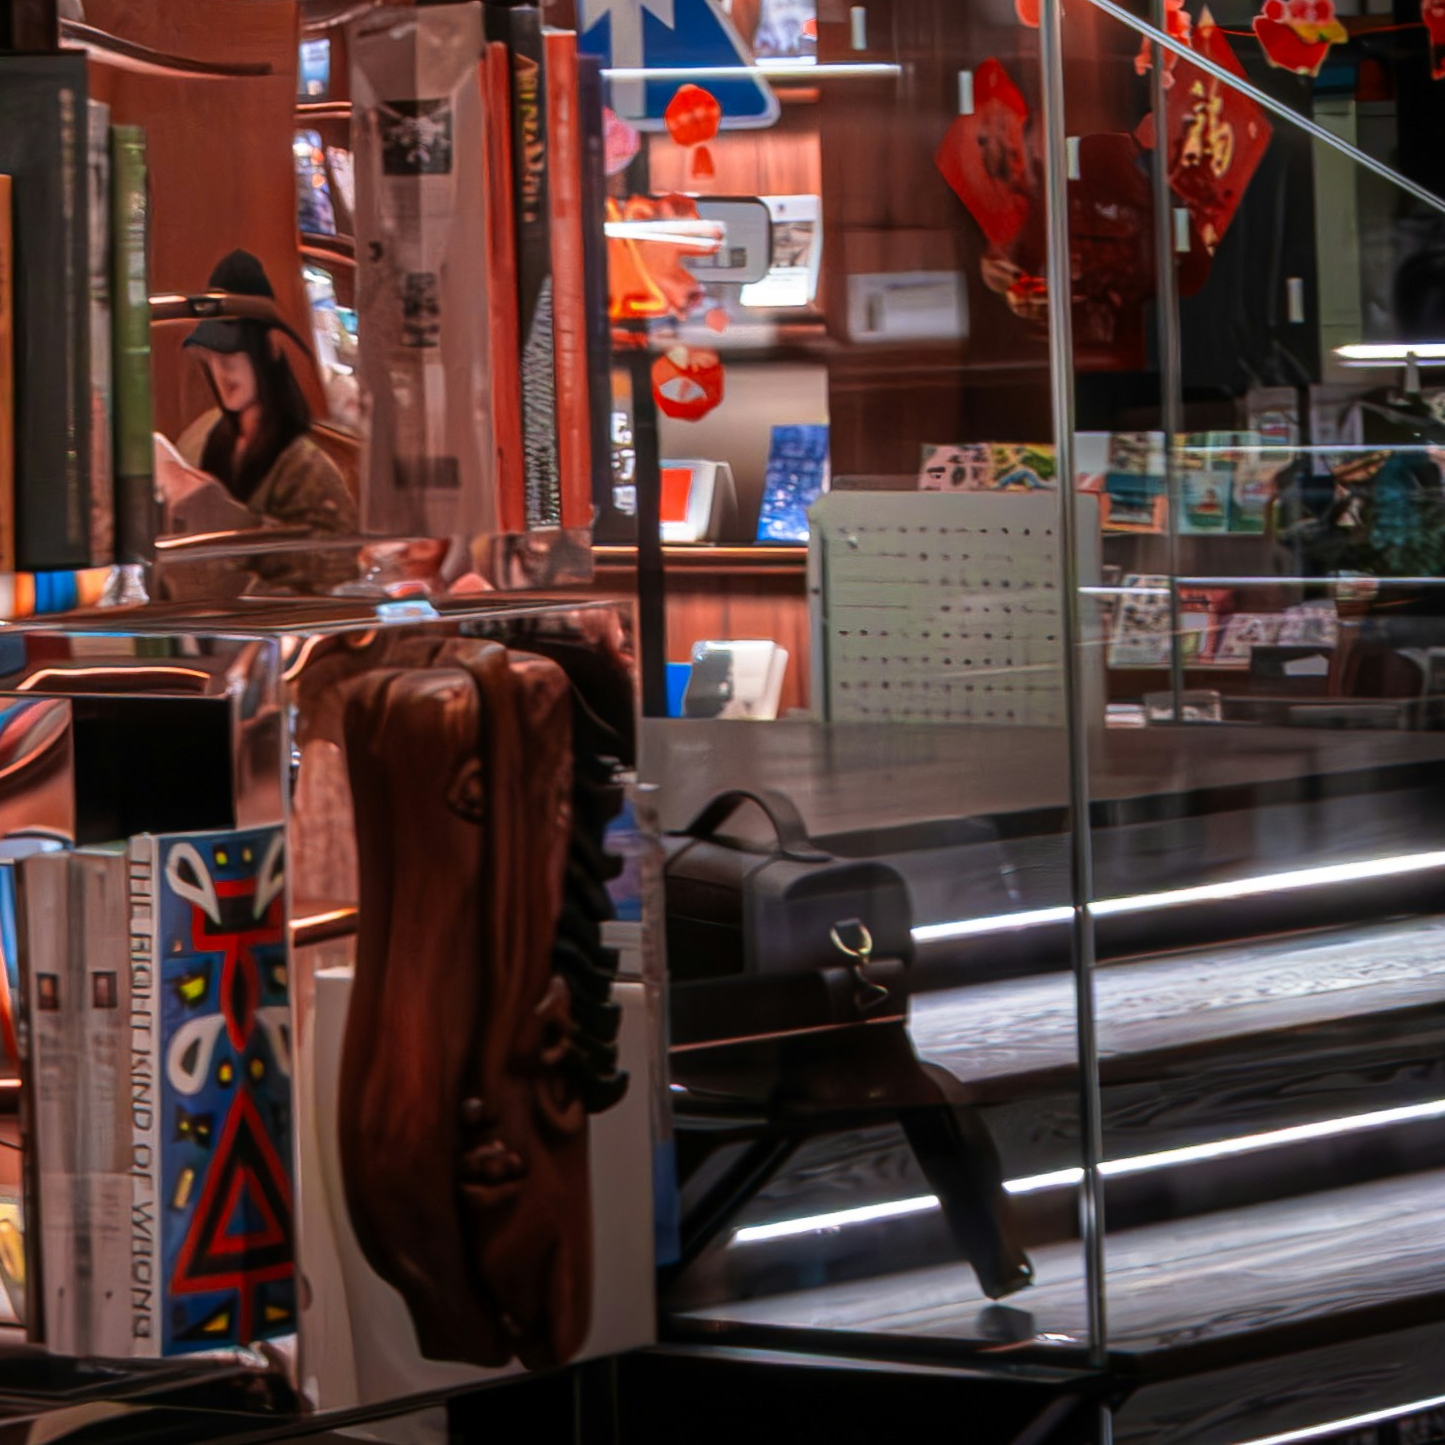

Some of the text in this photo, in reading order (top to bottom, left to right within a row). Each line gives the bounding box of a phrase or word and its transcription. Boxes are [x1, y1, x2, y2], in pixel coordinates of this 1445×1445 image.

[129, 857, 154, 921] THE
[129, 932, 154, 1039] RIGHT
[129, 1048, 154, 1131] KIND
[129, 1143, 154, 1188] OF
